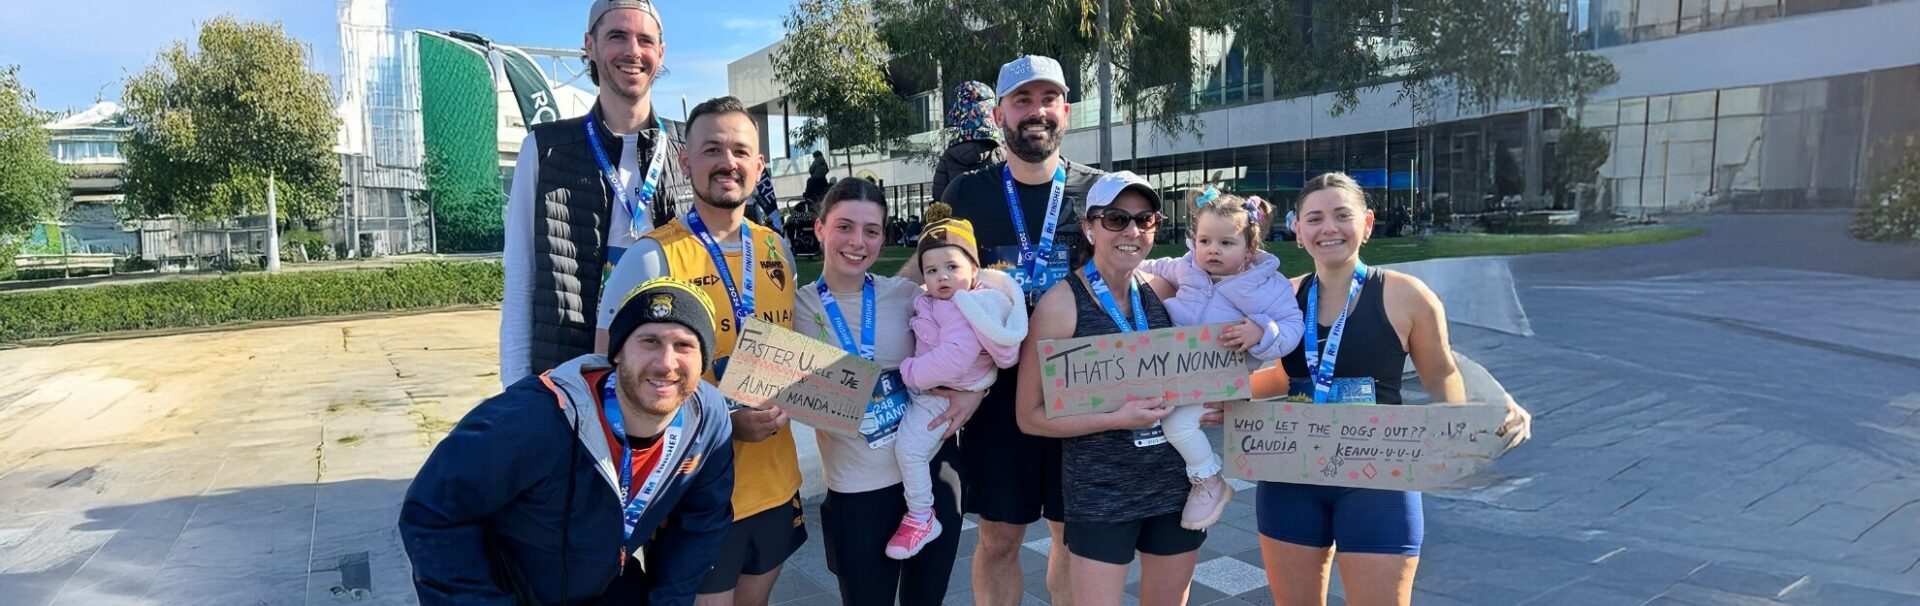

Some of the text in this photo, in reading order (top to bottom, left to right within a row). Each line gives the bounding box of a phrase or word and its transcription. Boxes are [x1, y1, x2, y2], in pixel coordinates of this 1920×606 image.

[1050, 186, 1061, 217] FINISHER
[744, 240, 753, 272] FINISHER
[738, 328, 860, 390] FASTER UNCLE JAE
[1046, 343, 1125, 388] THAT'S
[1137, 351, 1170, 378] MY
[737, 374, 784, 397] AUNTY
[1234, 418, 1264, 431] WHO
[1275, 420, 1299, 431] LET
[1308, 423, 1331, 435] THE
[1340, 425, 1376, 438] DOGS
